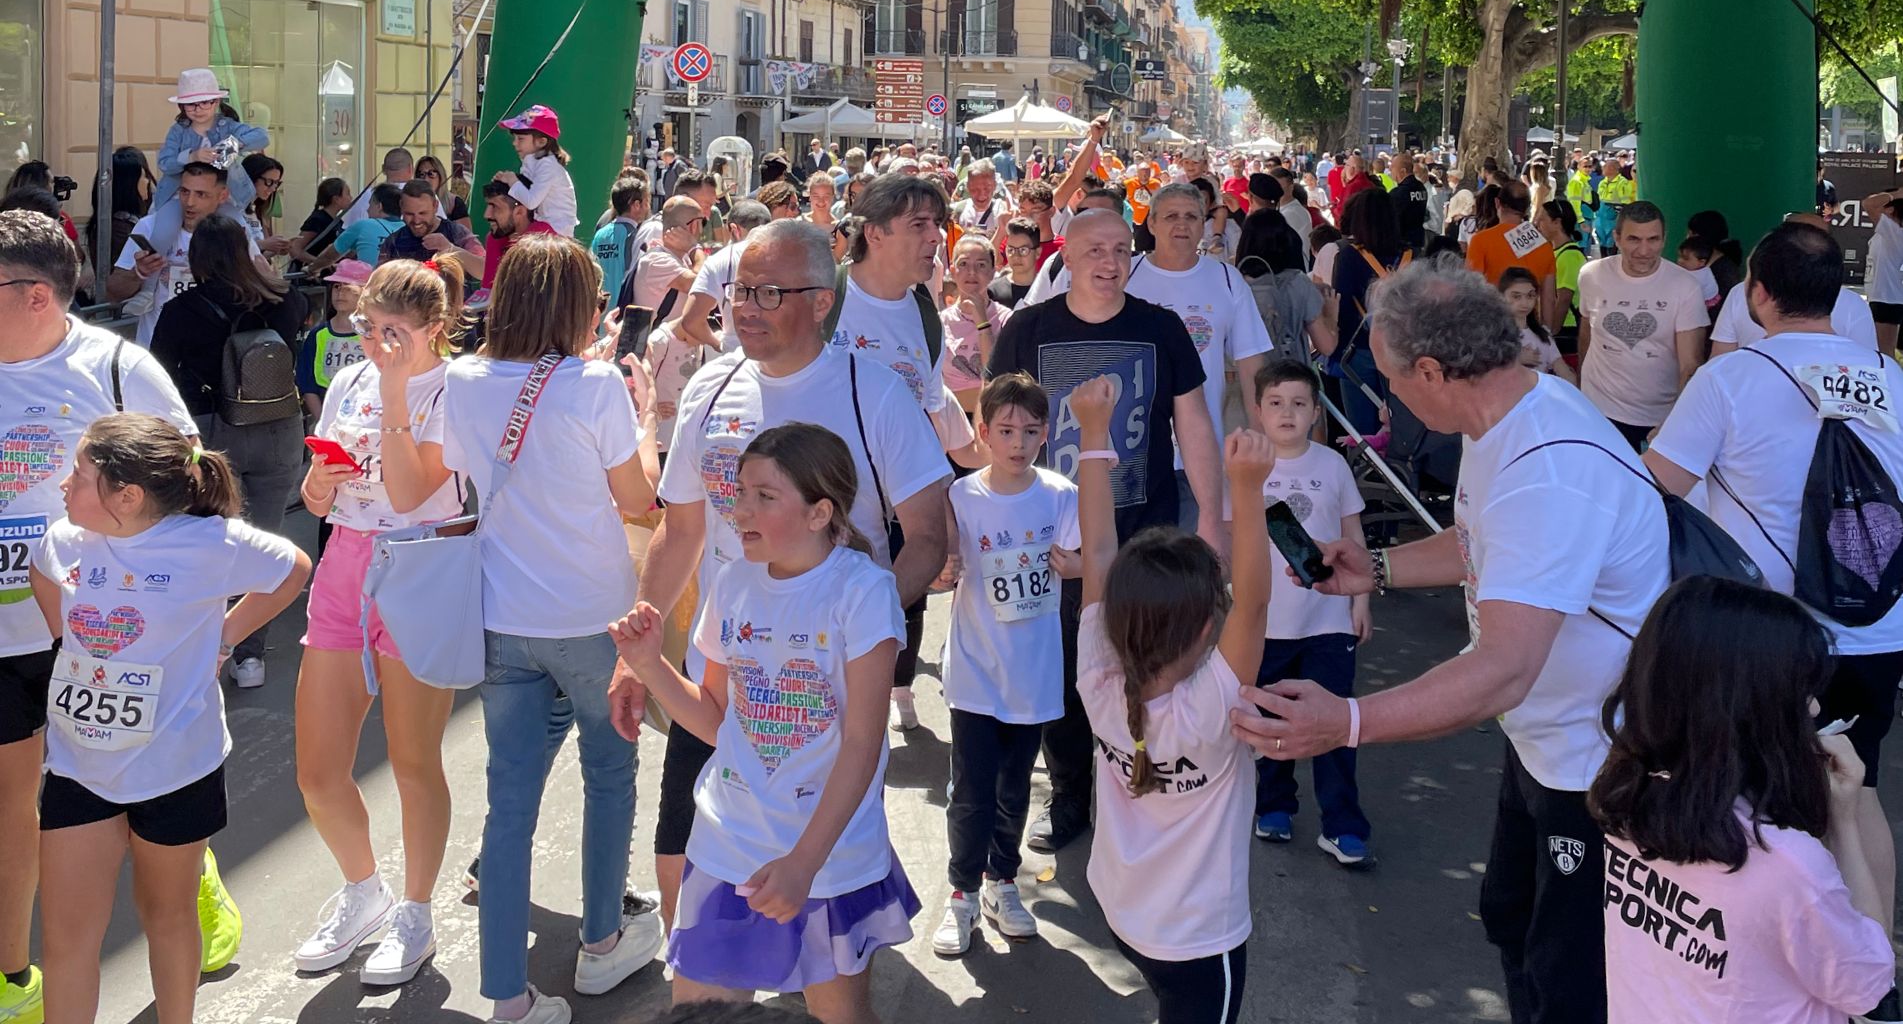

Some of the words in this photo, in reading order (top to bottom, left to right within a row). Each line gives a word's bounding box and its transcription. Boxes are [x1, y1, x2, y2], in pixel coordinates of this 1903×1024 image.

[1512, 229, 1539, 250] 10840
[5, 433, 51, 441] PARTNERSHIP
[4, 441, 31, 451] CUORE
[3, 451, 49, 463] PASSIONE
[0, 524, 45, 536] IZUNO
[5, 576, 30, 585] SPO
[992, 568, 1052, 603] 8182
[780, 668, 819, 681] PARTNERSHIP
[745, 675, 770, 688] PEGNO
[780, 678, 807, 693] CUORE
[55, 684, 144, 728] 4255
[780, 692, 824, 709] PASSIONE
[1550, 838, 1583, 857] NETS
[1562, 856, 1571, 869] B
[1604, 881, 1728, 979] PORT.com
